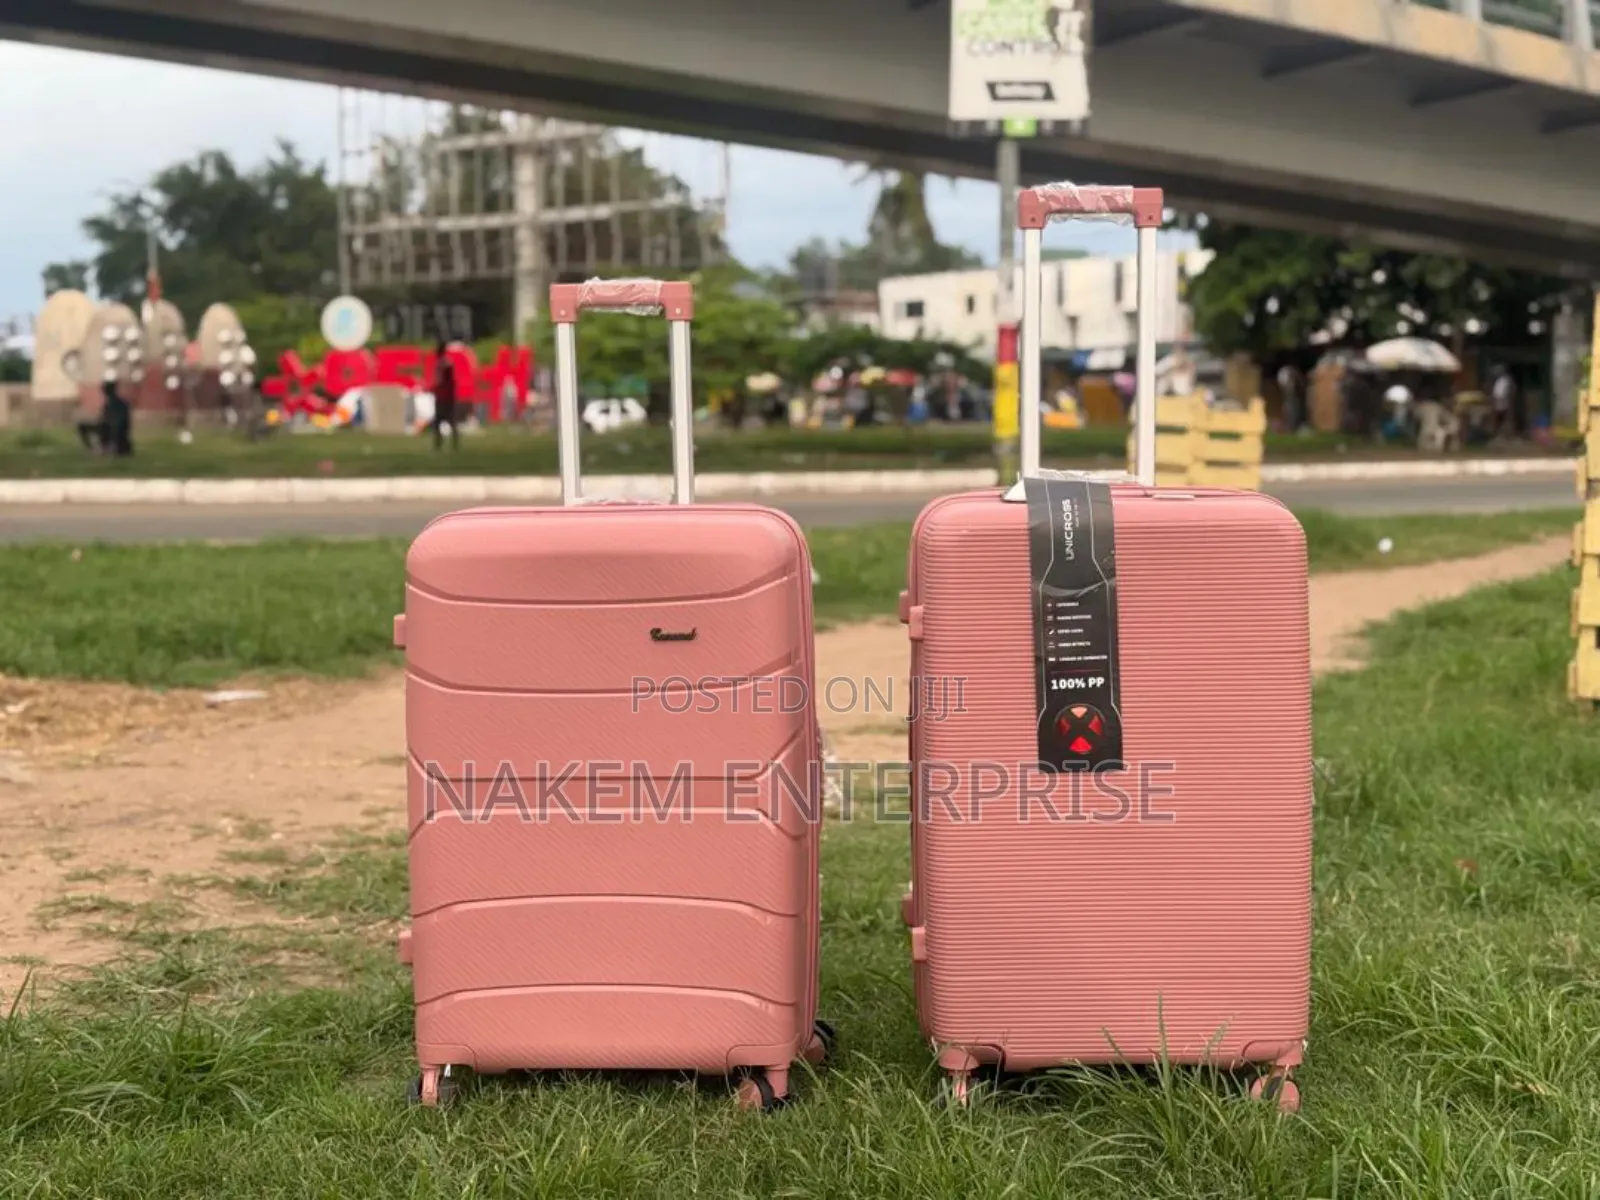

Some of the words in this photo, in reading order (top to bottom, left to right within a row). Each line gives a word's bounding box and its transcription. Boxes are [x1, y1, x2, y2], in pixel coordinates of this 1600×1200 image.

[1062, 498, 1075, 561] UNICROSS
[1051, 678, 1086, 690] 100%
[1088, 676, 1105, 688] PP
